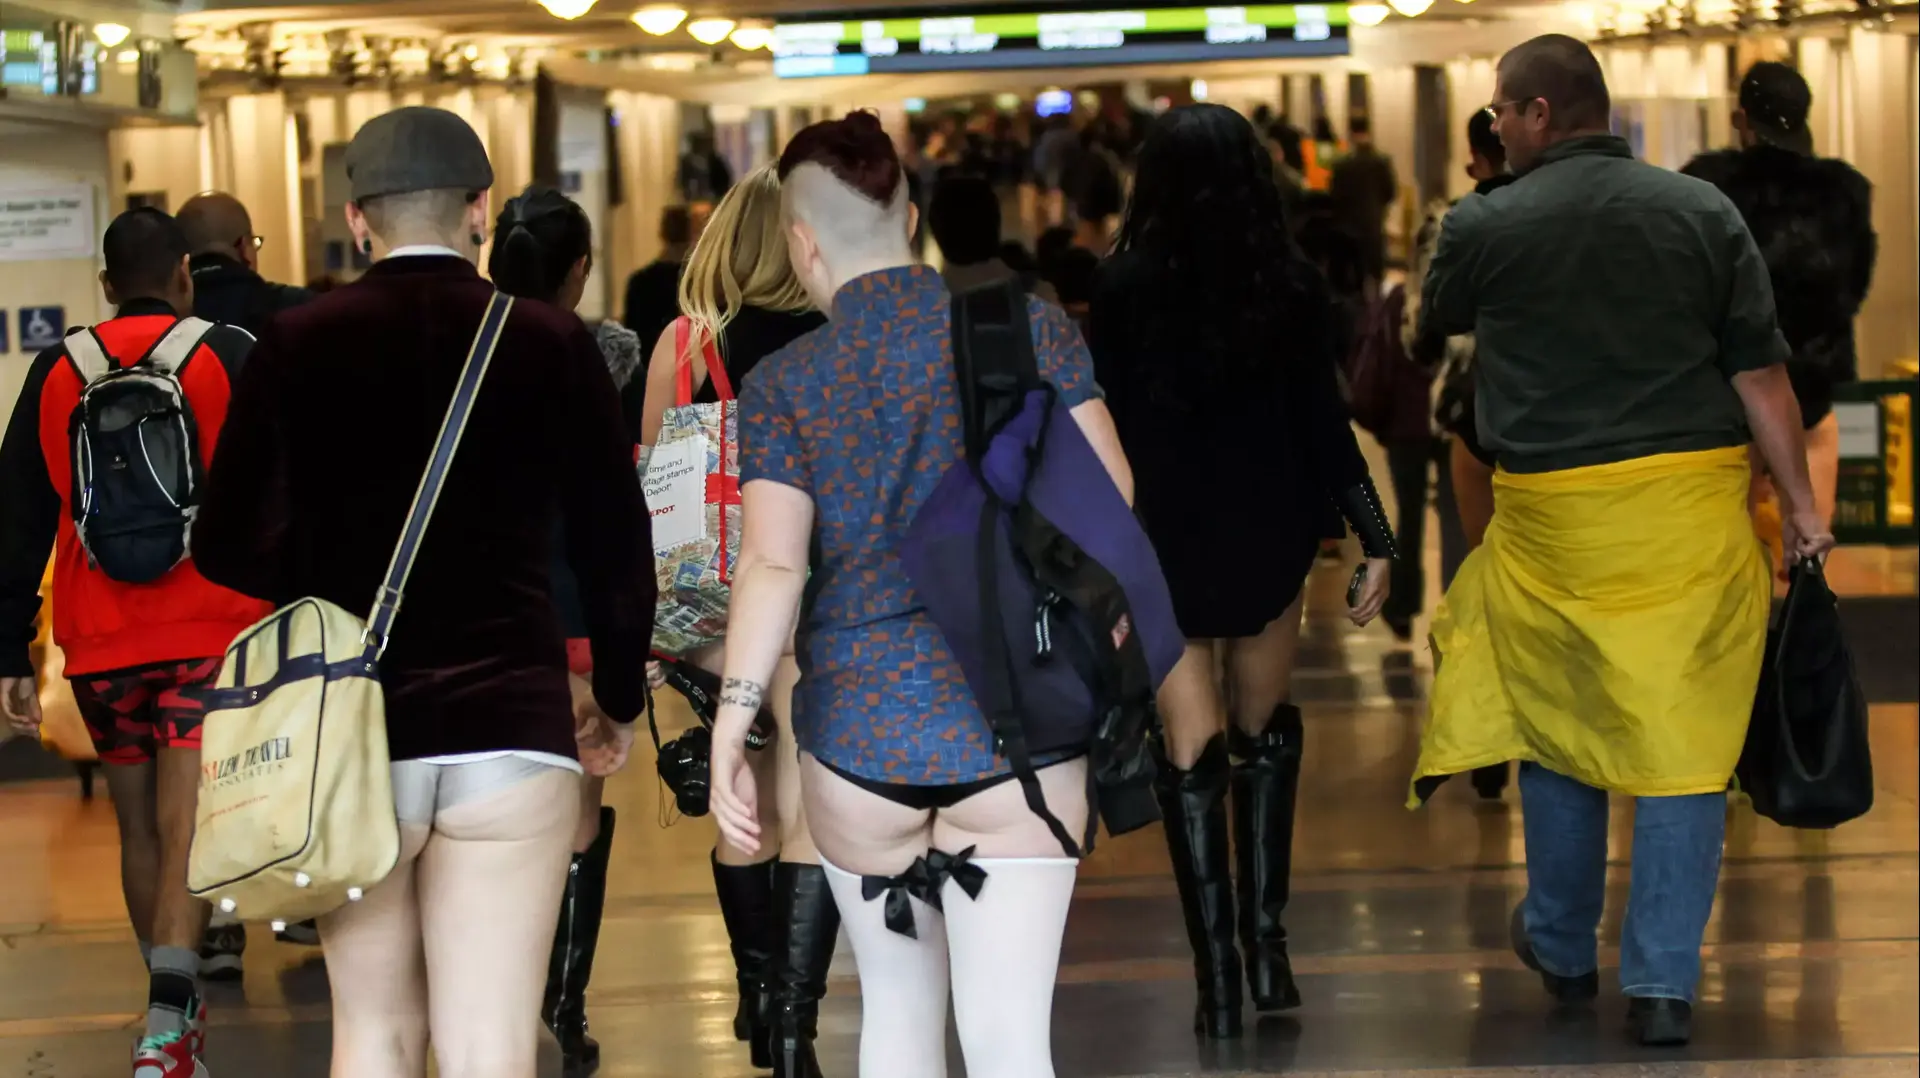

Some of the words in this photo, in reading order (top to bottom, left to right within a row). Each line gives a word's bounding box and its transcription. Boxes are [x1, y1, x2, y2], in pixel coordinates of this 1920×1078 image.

[649, 464, 666, 474] time
[667, 458, 683, 468] and
[666, 465, 695, 480] stamps
